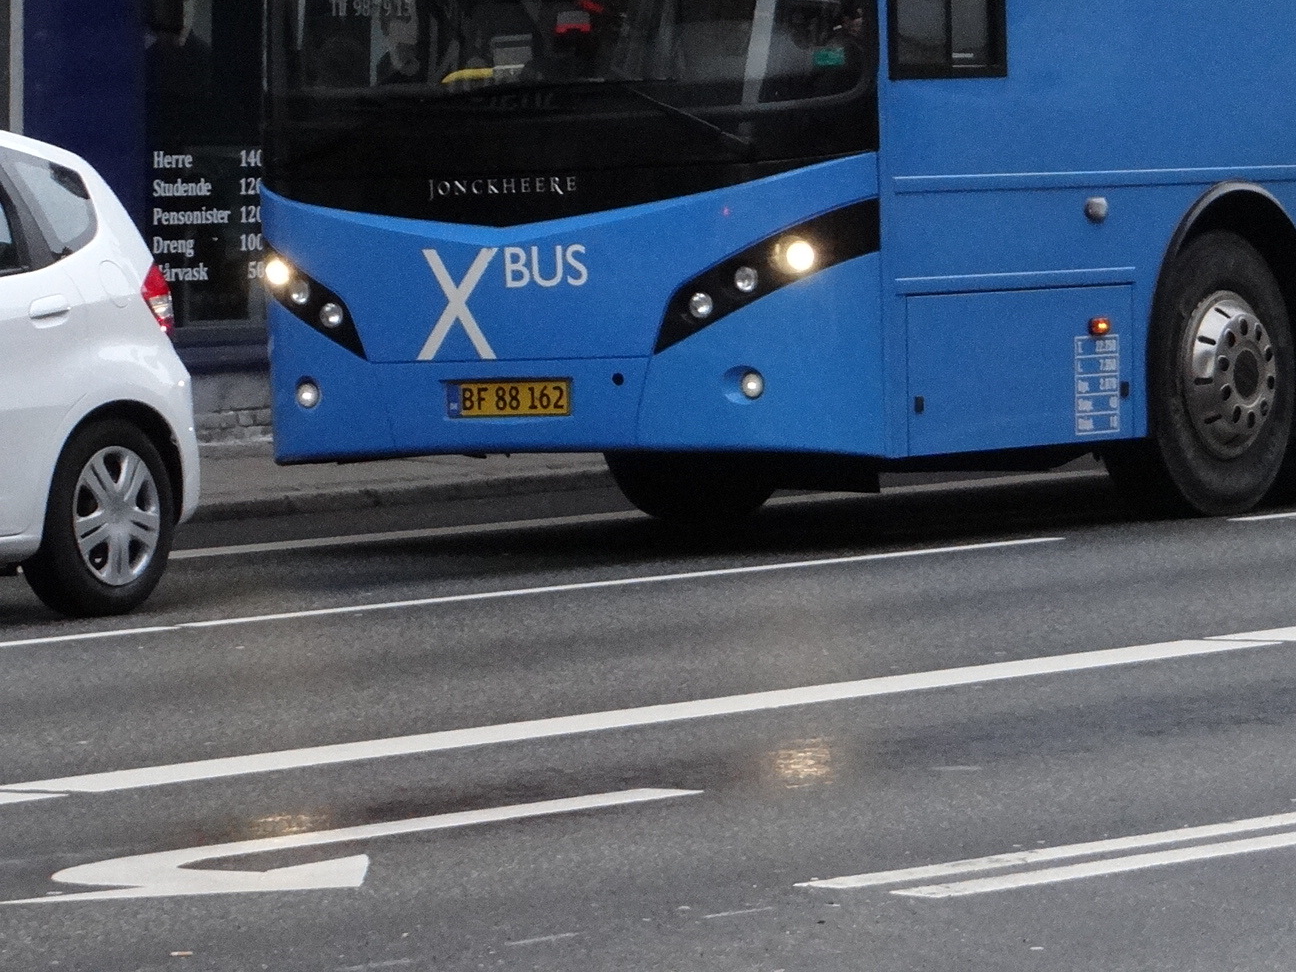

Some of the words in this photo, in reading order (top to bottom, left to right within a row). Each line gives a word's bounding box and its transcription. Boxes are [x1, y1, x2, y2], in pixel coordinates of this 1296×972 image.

[153, 150, 193, 168] Herre
[153, 178, 212, 197] Studende
[428, 176, 577, 200] JONCKHEERE
[153, 206, 231, 226] Pensonister
[153, 236, 195, 257] Dreng
[158, 262, 208, 281] årvask
[416, 247, 498, 360] X
[504, 243, 588, 288] BUS
[461, 385, 488, 411] BF
[495, 385, 521, 411] 88
[527, 384, 565, 411] 162
